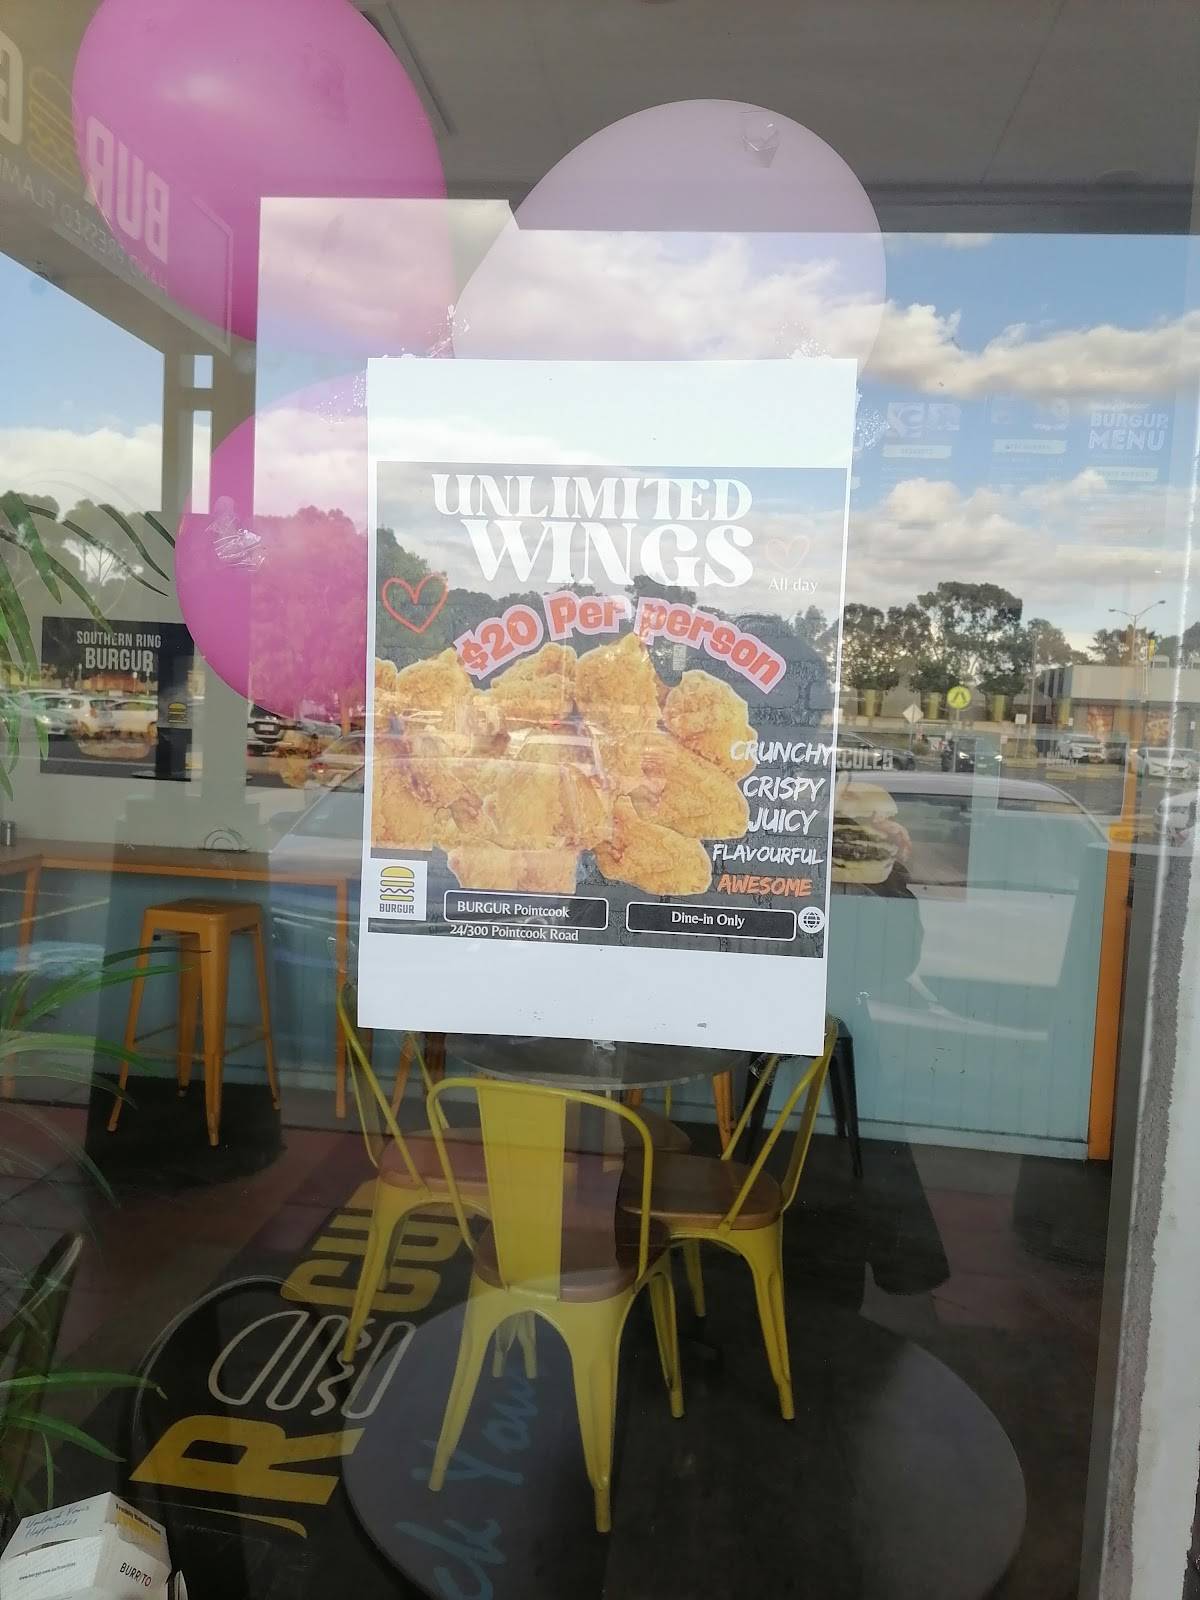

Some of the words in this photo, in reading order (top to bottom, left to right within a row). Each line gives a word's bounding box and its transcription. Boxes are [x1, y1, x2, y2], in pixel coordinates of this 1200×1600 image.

[1087, 430, 1165, 451] MENU
[431, 473, 753, 522] UNLIMITED
[460, 519, 754, 588] WINGS
[768, 577, 788, 591] All
[793, 577, 818, 594] day
[77, 631, 132, 647] SOUTHERN
[136, 634, 161, 648] RING
[459, 603, 540, 673] $20
[547, 595, 630, 636] Per
[640, 602, 782, 684] person
[85, 647, 154, 671] BURGUR
[730, 740, 837, 766] CRUNCHY
[742, 775, 826, 802] CRISPY
[748, 807, 820, 835] JUICY
[712, 843, 825, 866] FLAVOURFUL
[717, 874, 812, 897] AWESOME
[379, 903, 415, 915] BURGUR
[457, 901, 511, 914] BURGUR
[514, 903, 570, 919] Pointcook
[671, 911, 713, 926] Dine-in
[716, 914, 746, 929] Only
[450, 923, 489, 937] 24/300
[492, 927, 546, 940] Pointcook
[552, 929, 579, 942] Road
[119, 1562, 152, 1587] BURRITO
